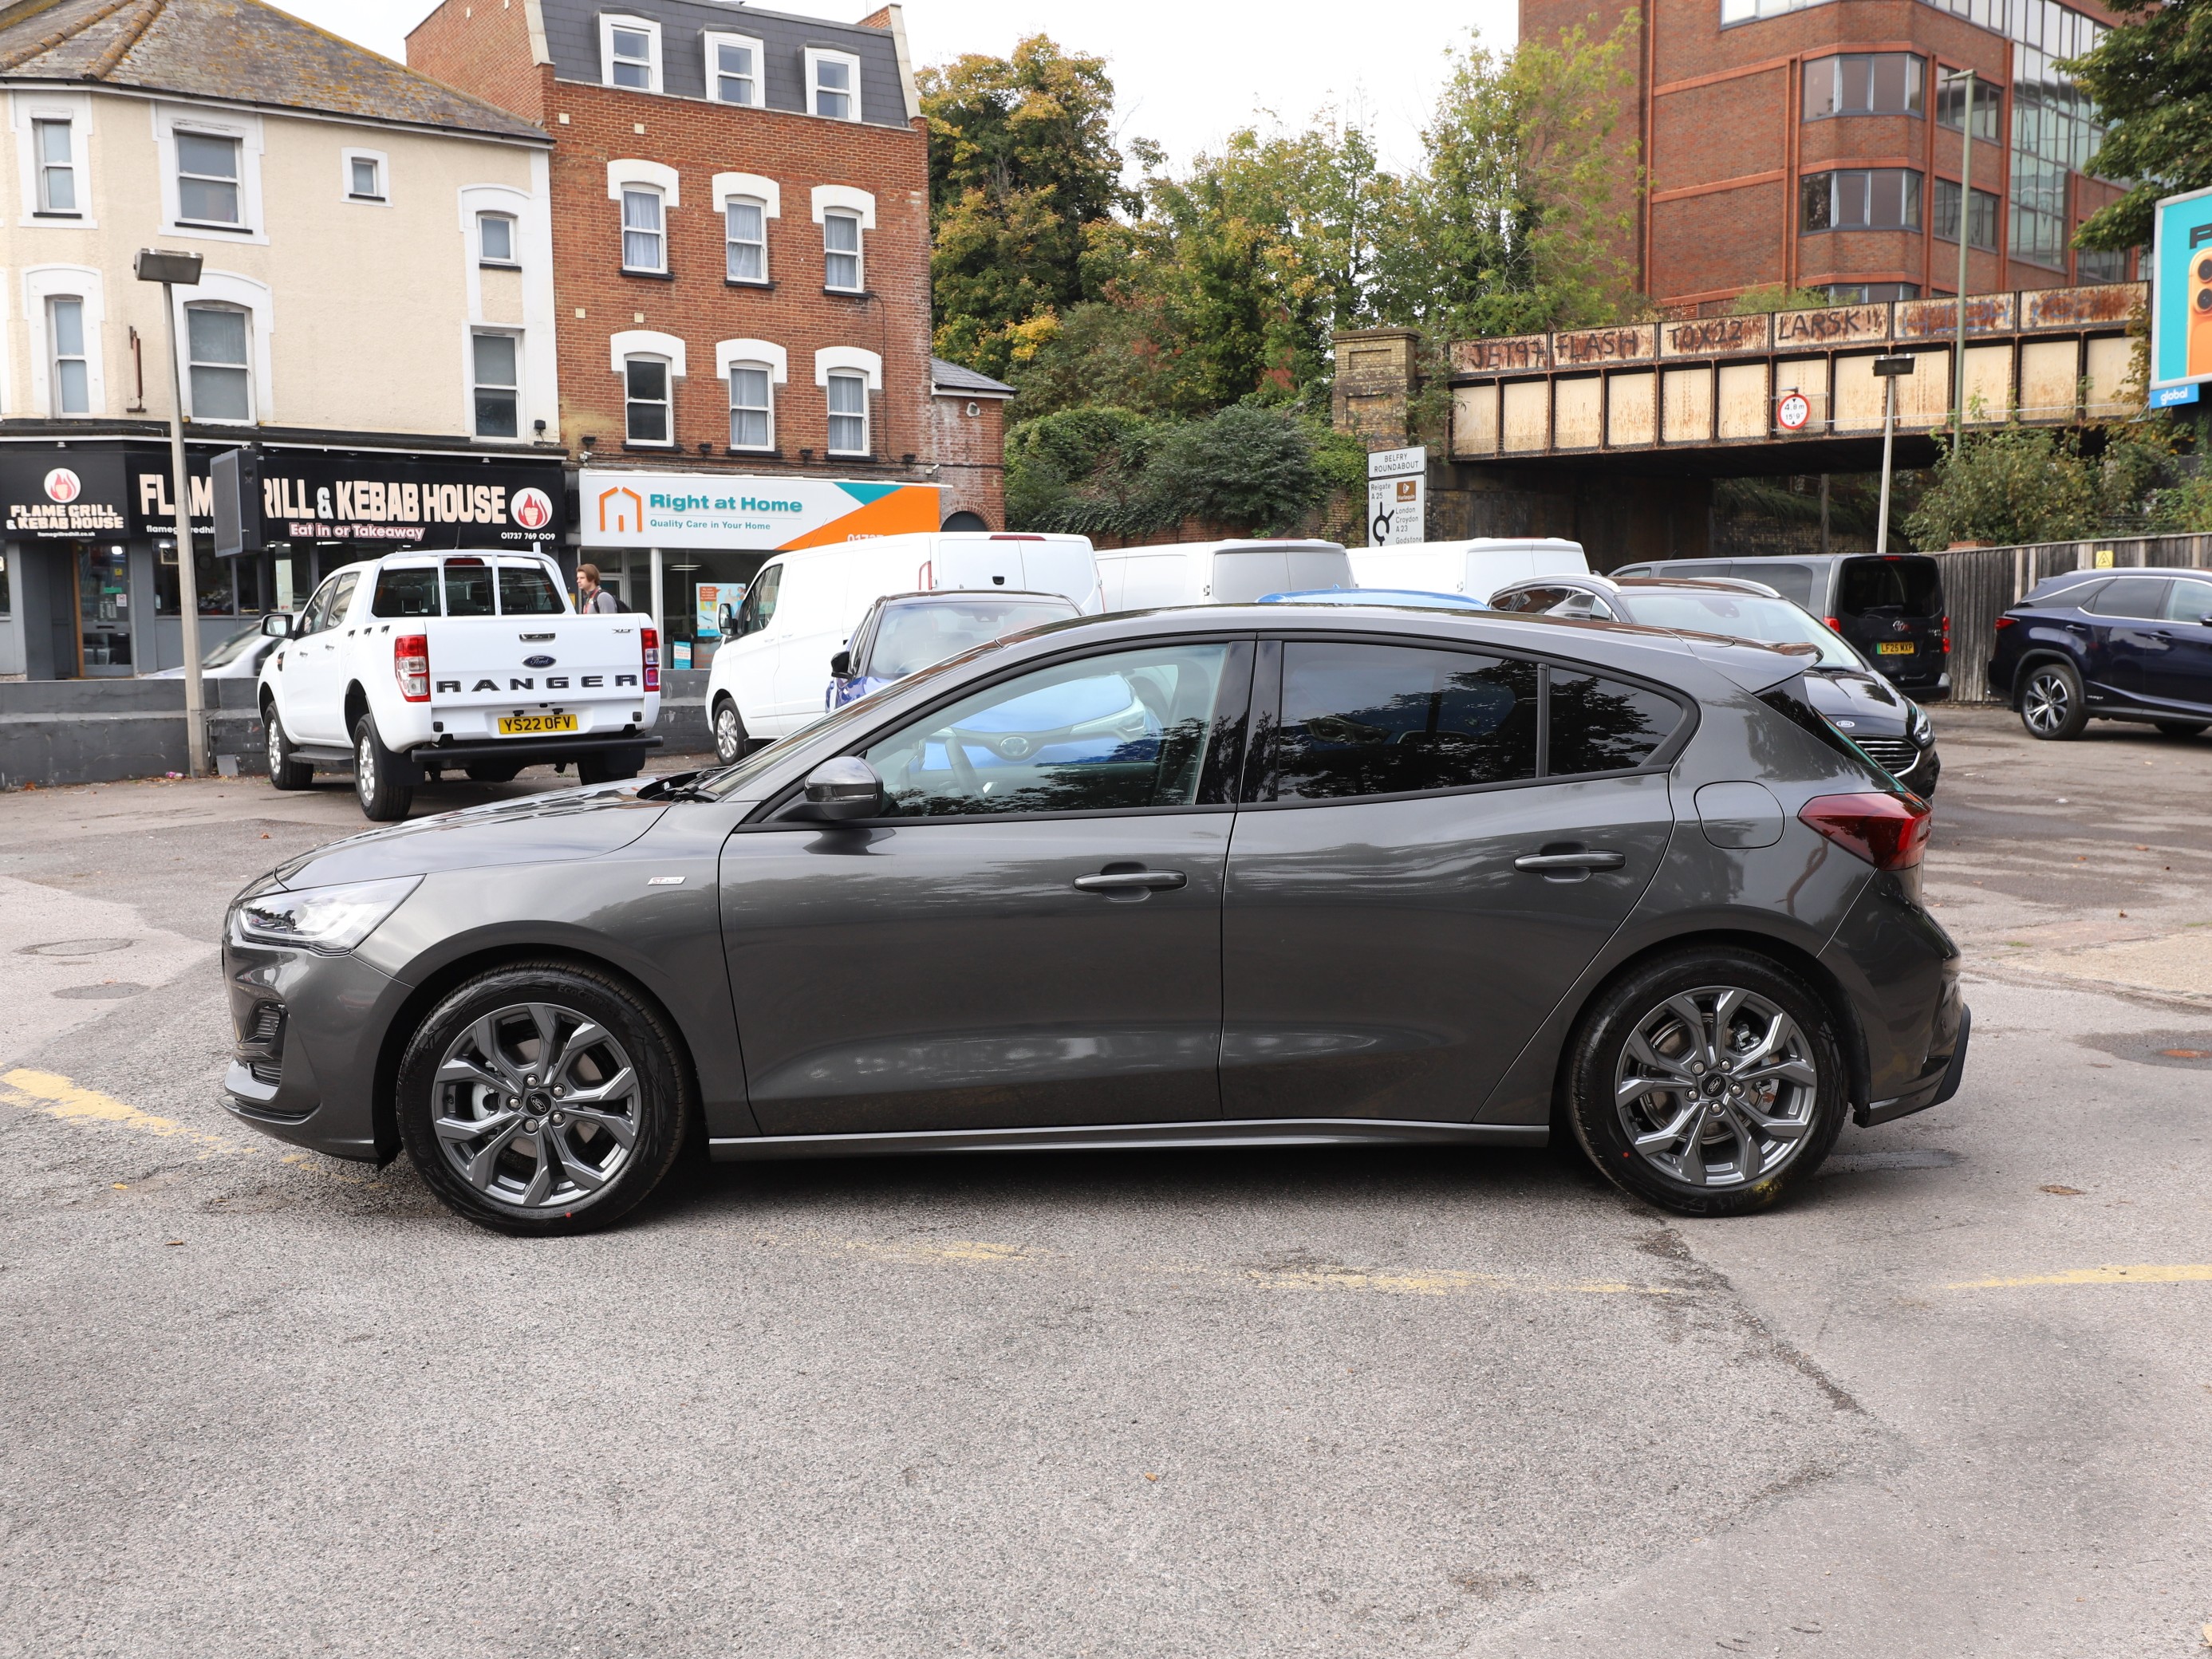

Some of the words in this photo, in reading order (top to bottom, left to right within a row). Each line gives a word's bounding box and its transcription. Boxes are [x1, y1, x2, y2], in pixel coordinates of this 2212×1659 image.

[1555, 330, 1636, 359] FLASH
[2160, 387, 2188, 405] global
[1385, 453, 1408, 462] BELFRY
[1374, 461, 1418, 472] ROUNDABOUT
[263, 478, 315, 519] RILL
[317, 487, 334, 519] &
[335, 480, 420, 522] KEBAB
[422, 483, 507, 524] HOUSE
[650, 494, 709, 511] Right
[715, 496, 735, 510] at
[740, 496, 802, 513] Home
[10, 504, 66, 518] FLAME
[68, 504, 118, 518] GRILL
[18, 517, 69, 530] KEBAB
[70, 516, 124, 530] HOUSE
[650, 518, 683, 529] Quality
[711, 520, 719, 529] in
[290, 522, 313, 538] Eat
[315, 523, 332, 538] in
[333, 526, 350, 538] or
[352, 524, 425, 542] Takeaway
[539, 532, 556, 541] 009
[436, 674, 638, 693] RANGER
[504, 717, 542, 731] YS22
[545, 716, 570, 729] OFV
